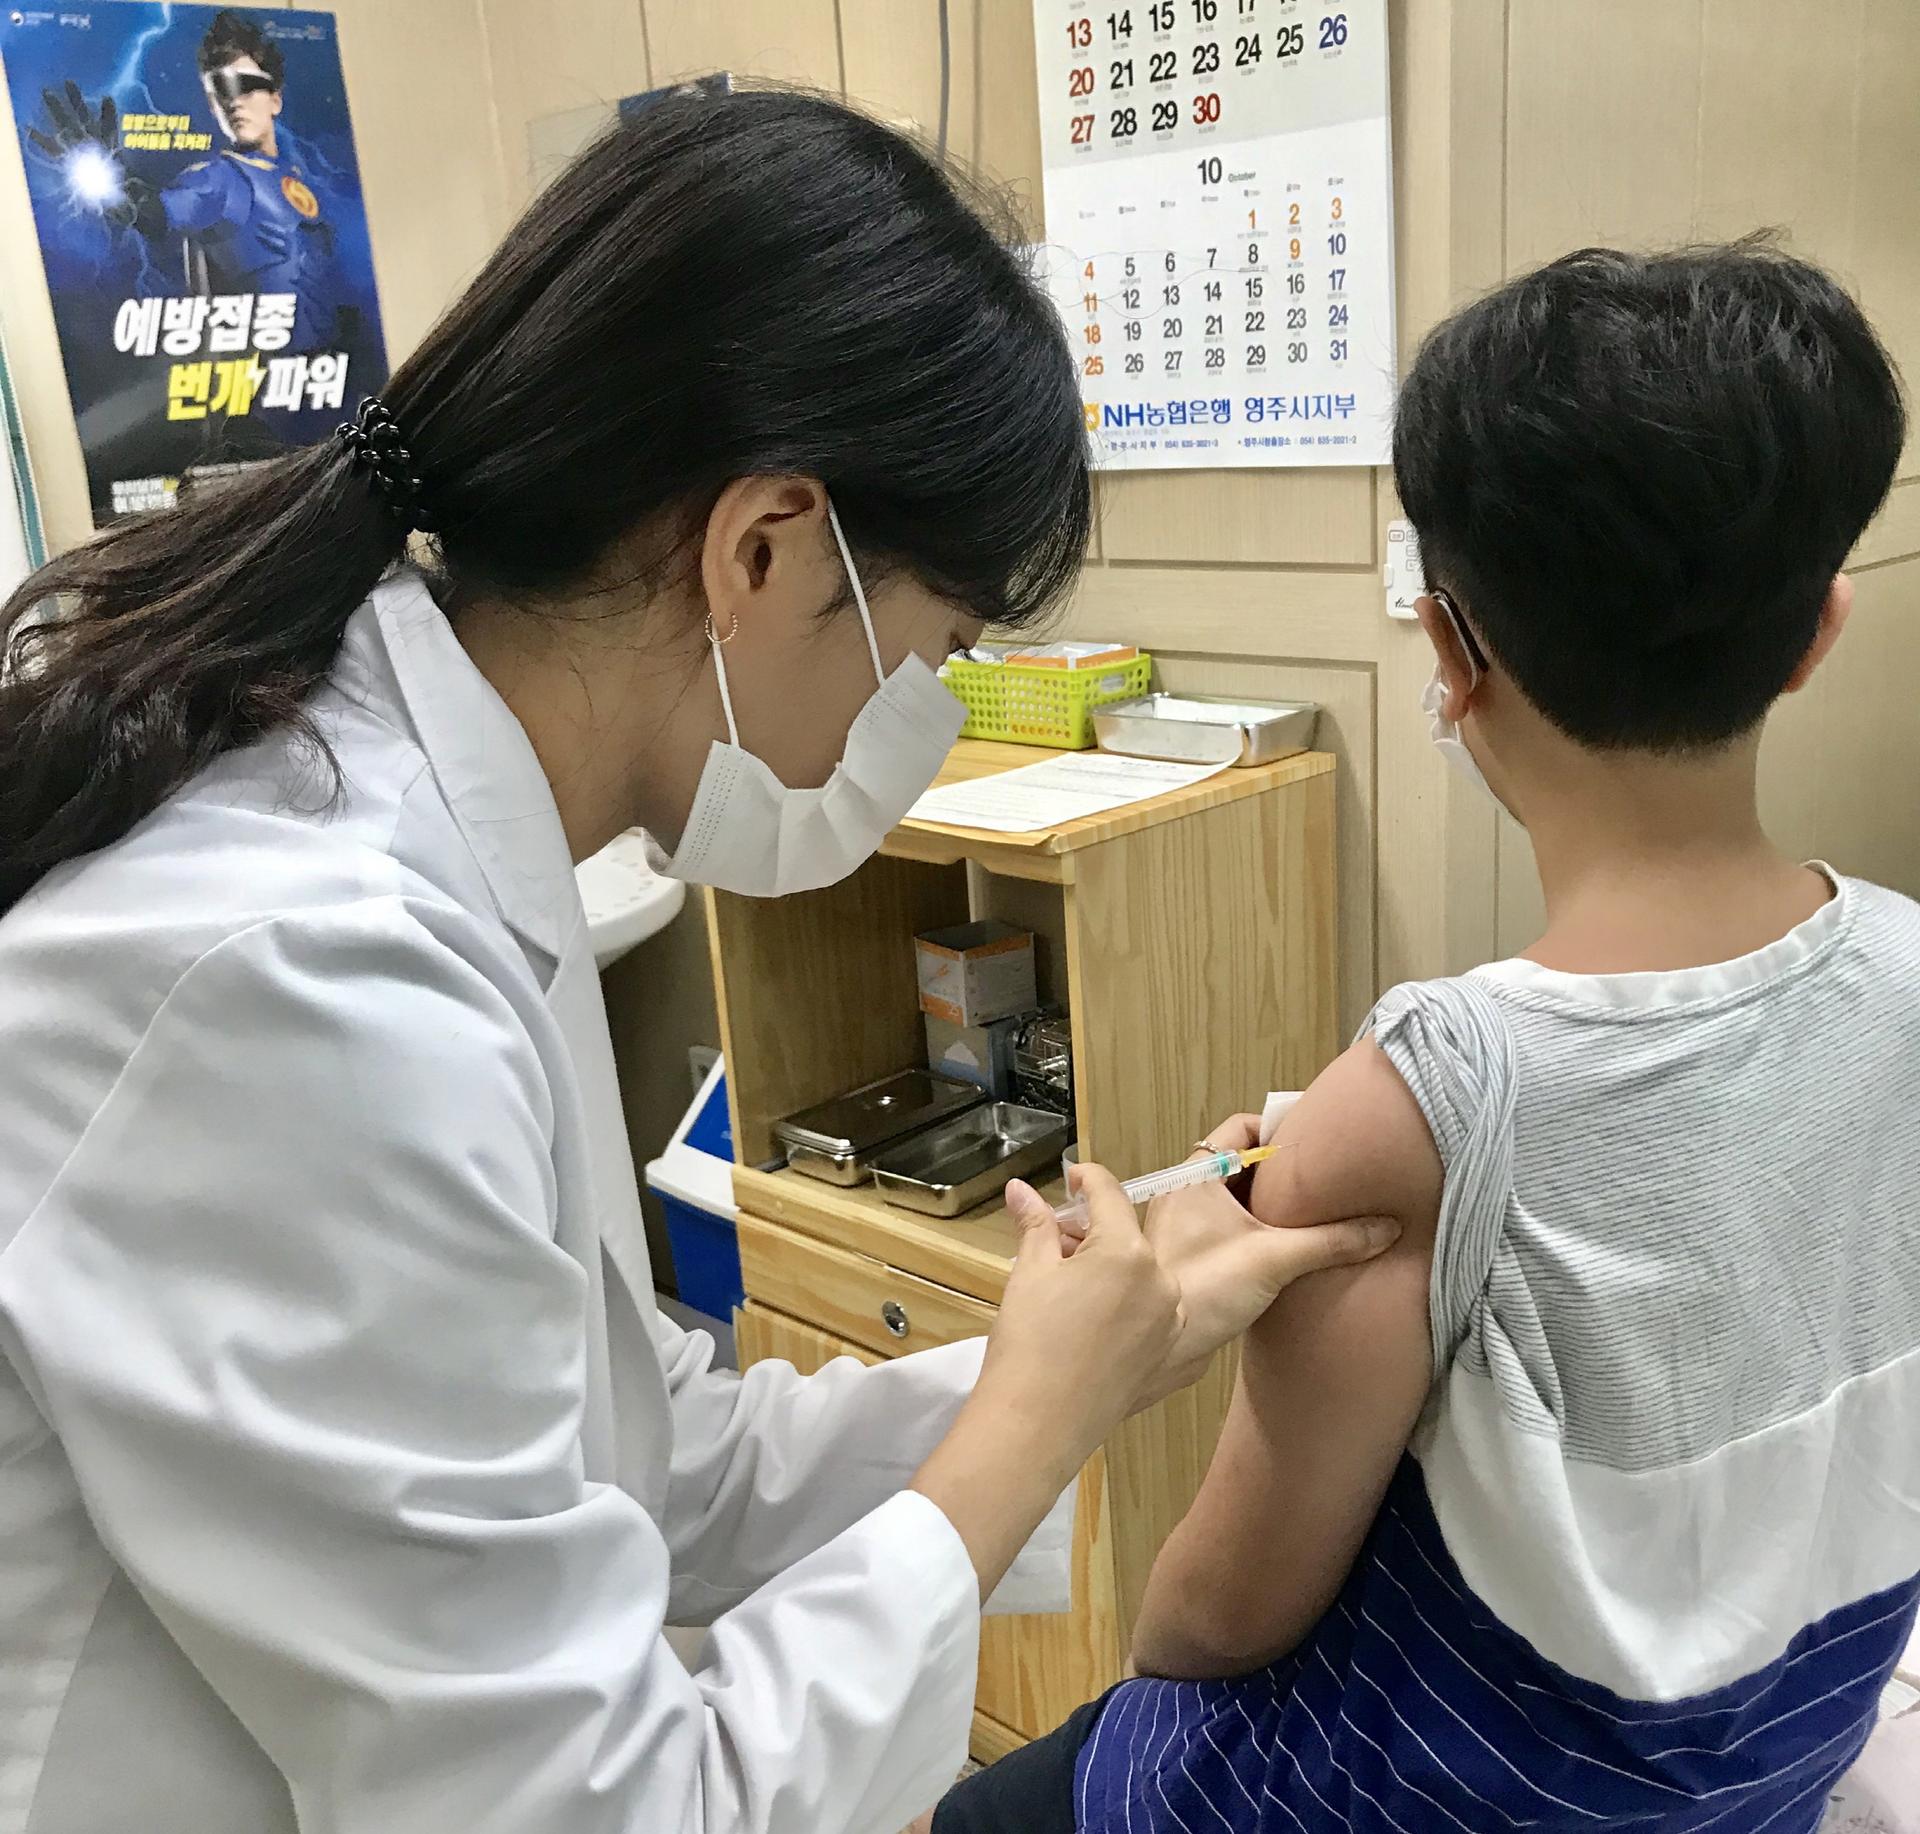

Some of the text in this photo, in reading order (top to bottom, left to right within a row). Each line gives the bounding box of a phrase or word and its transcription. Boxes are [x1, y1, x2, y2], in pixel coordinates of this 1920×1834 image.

[1066, 18, 1093, 49] 13
[1107, 9, 1133, 41] 14
[1149, 0, 1176, 33] 15
[1191, 0, 1218, 24] 16
[1069, 13, 1348, 98] 20 21 22 23 24 25 26
[1070, 92, 1221, 145] 27 28 29 30
[1197, 157, 1256, 185] 10 October
[1248, 197, 1342, 230] 1 2 3
[1084, 233, 1346, 280] 4 5 6 7 8 9 10
[1083, 269, 1346, 312] 11 12 13 14 15 16 17
[113, 293, 297, 356] 예방접종
[1084, 304, 1349, 345] 18 19 20 21 22 23 24
[1084, 339, 1348, 376] 25 26 27 28 29 30 31
[167, 352, 349, 420] 번개 파워
[1103, 394, 1356, 428] NH농협은행 영주시지부
